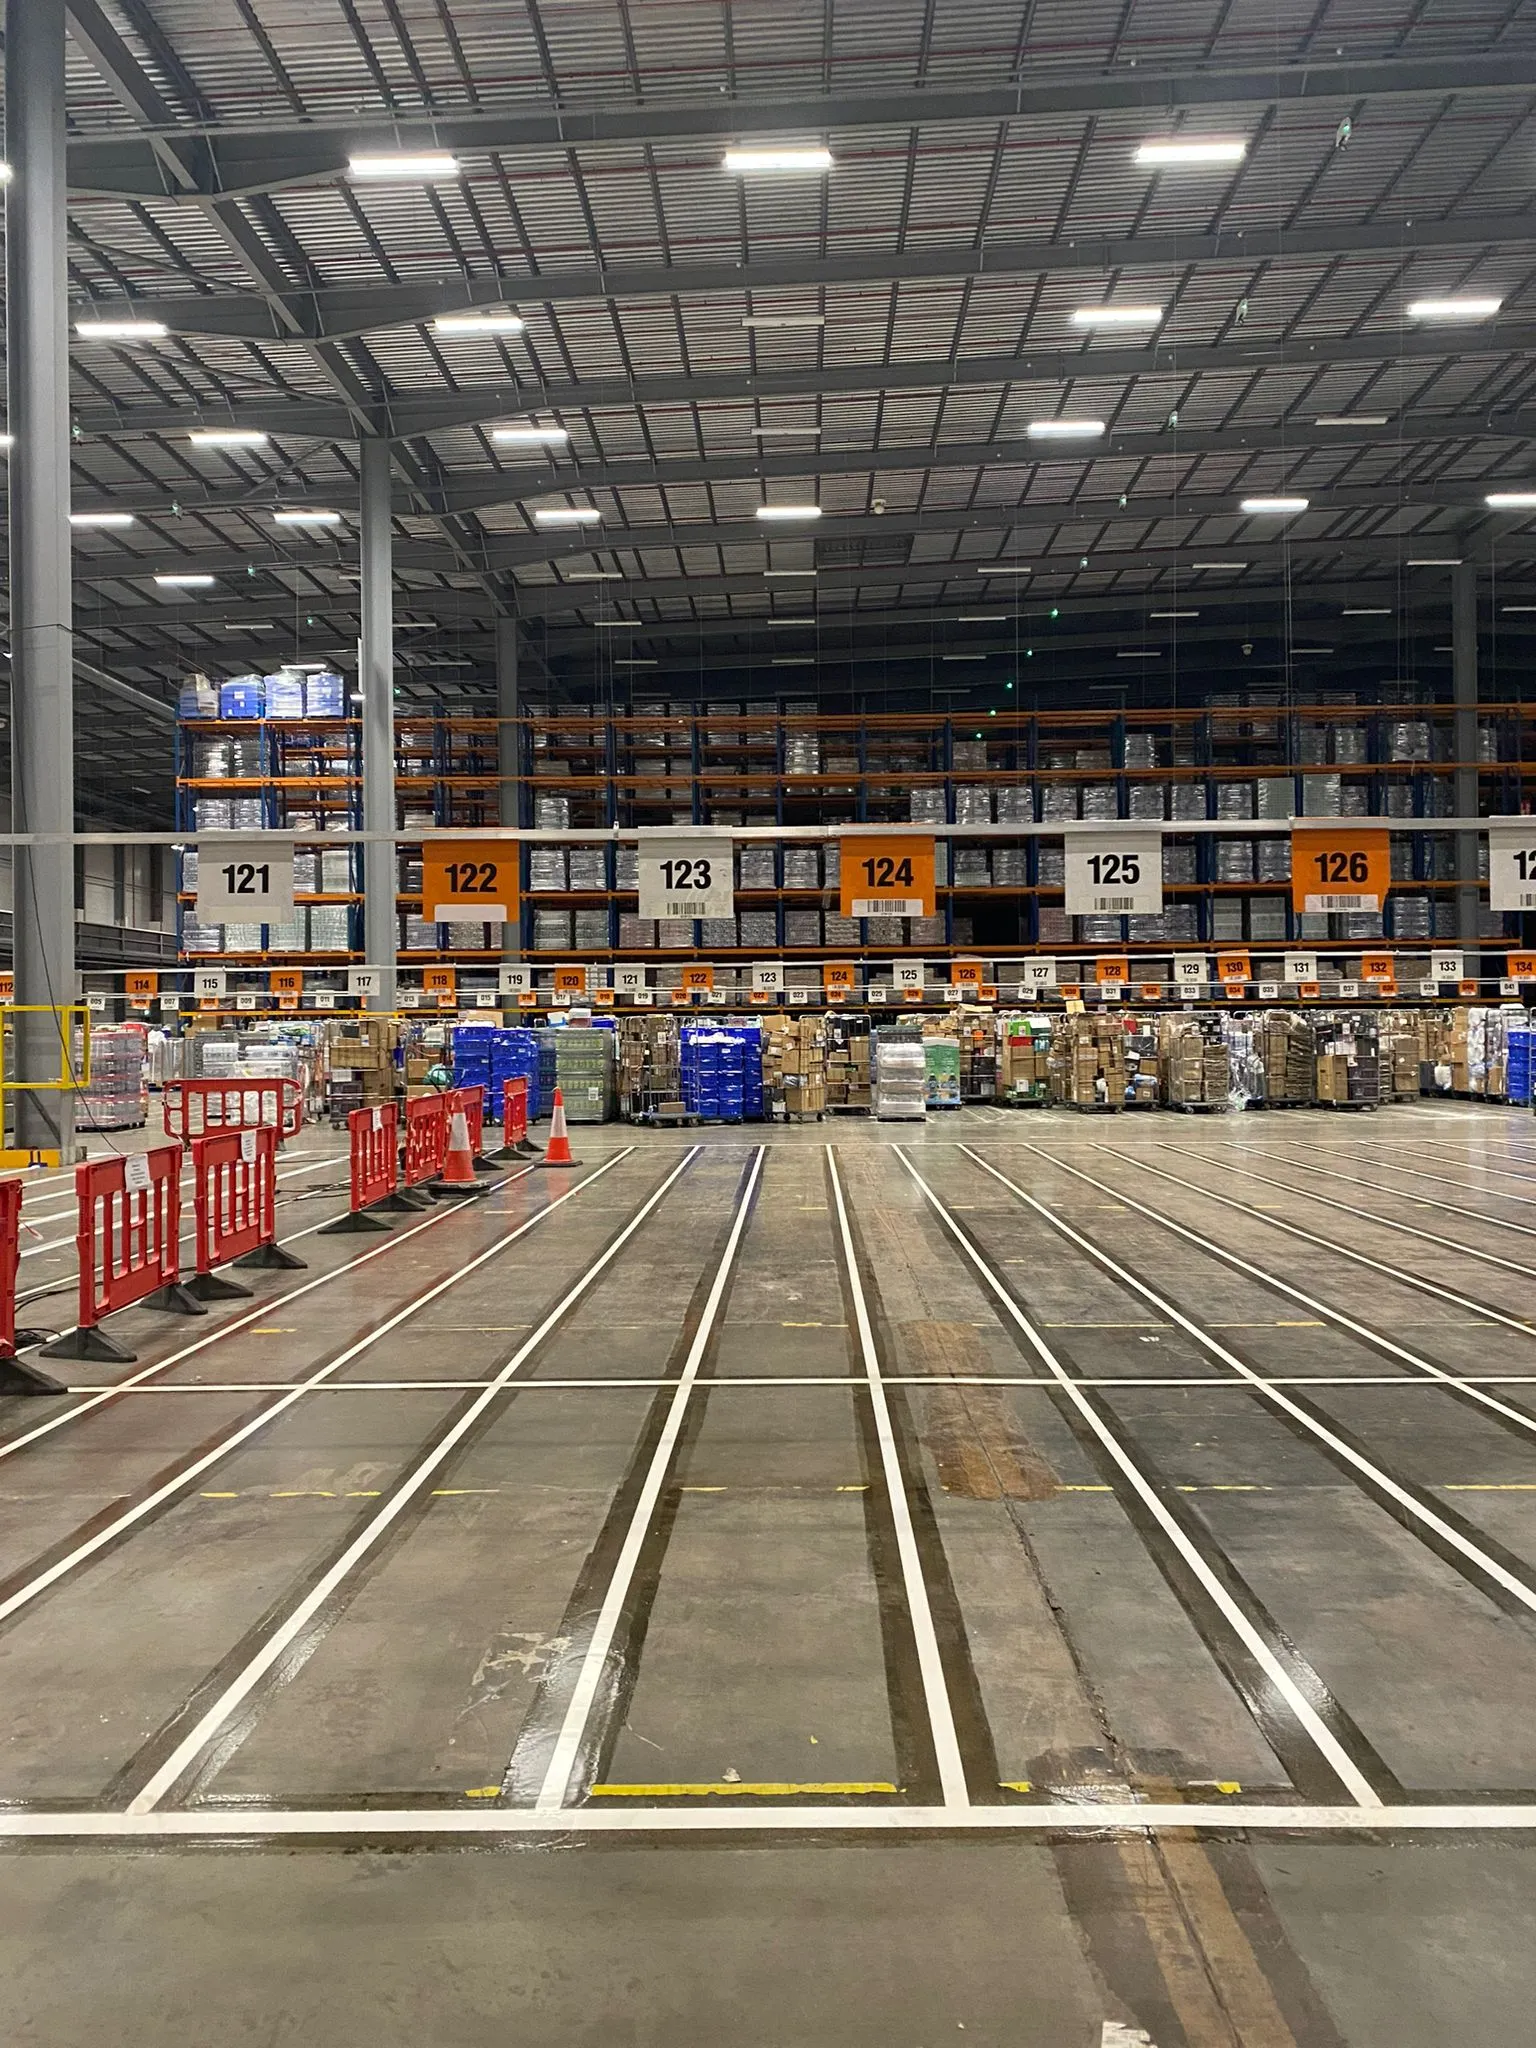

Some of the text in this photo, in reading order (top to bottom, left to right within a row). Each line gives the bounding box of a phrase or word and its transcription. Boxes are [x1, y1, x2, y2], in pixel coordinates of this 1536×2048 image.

[862, 857, 914, 887] 124
[1087, 854, 1140, 884] 125
[1314, 852, 1368, 882] 126
[222, 864, 269, 893] 121
[445, 863, 497, 892] 122
[660, 860, 711, 889] 123
[1103, 966, 1121, 976] 128
[1182, 964, 1199, 974] 129
[1225, 962, 1243, 972] 130
[1293, 963, 1309, 972] 131
[1369, 962, 1387, 972] 132
[1439, 961, 1456, 971] 133
[1515, 962, 1532, 972] 134
[760, 972, 777, 983] 123
[831, 971, 848, 981] 124
[900, 970, 917, 980] 125
[958, 969, 976, 979] 126
[1032, 968, 1049, 978] 127
[202, 978, 218, 989] 115
[278, 977, 294, 987] 116
[356, 977, 371, 986] 117
[431, 975, 447, 985] 118
[507, 975, 523, 985] 119
[562, 976, 578, 986] 120
[622, 975, 638, 984] 121
[689, 973, 707, 984] 122
[134, 980, 149, 990] 114
